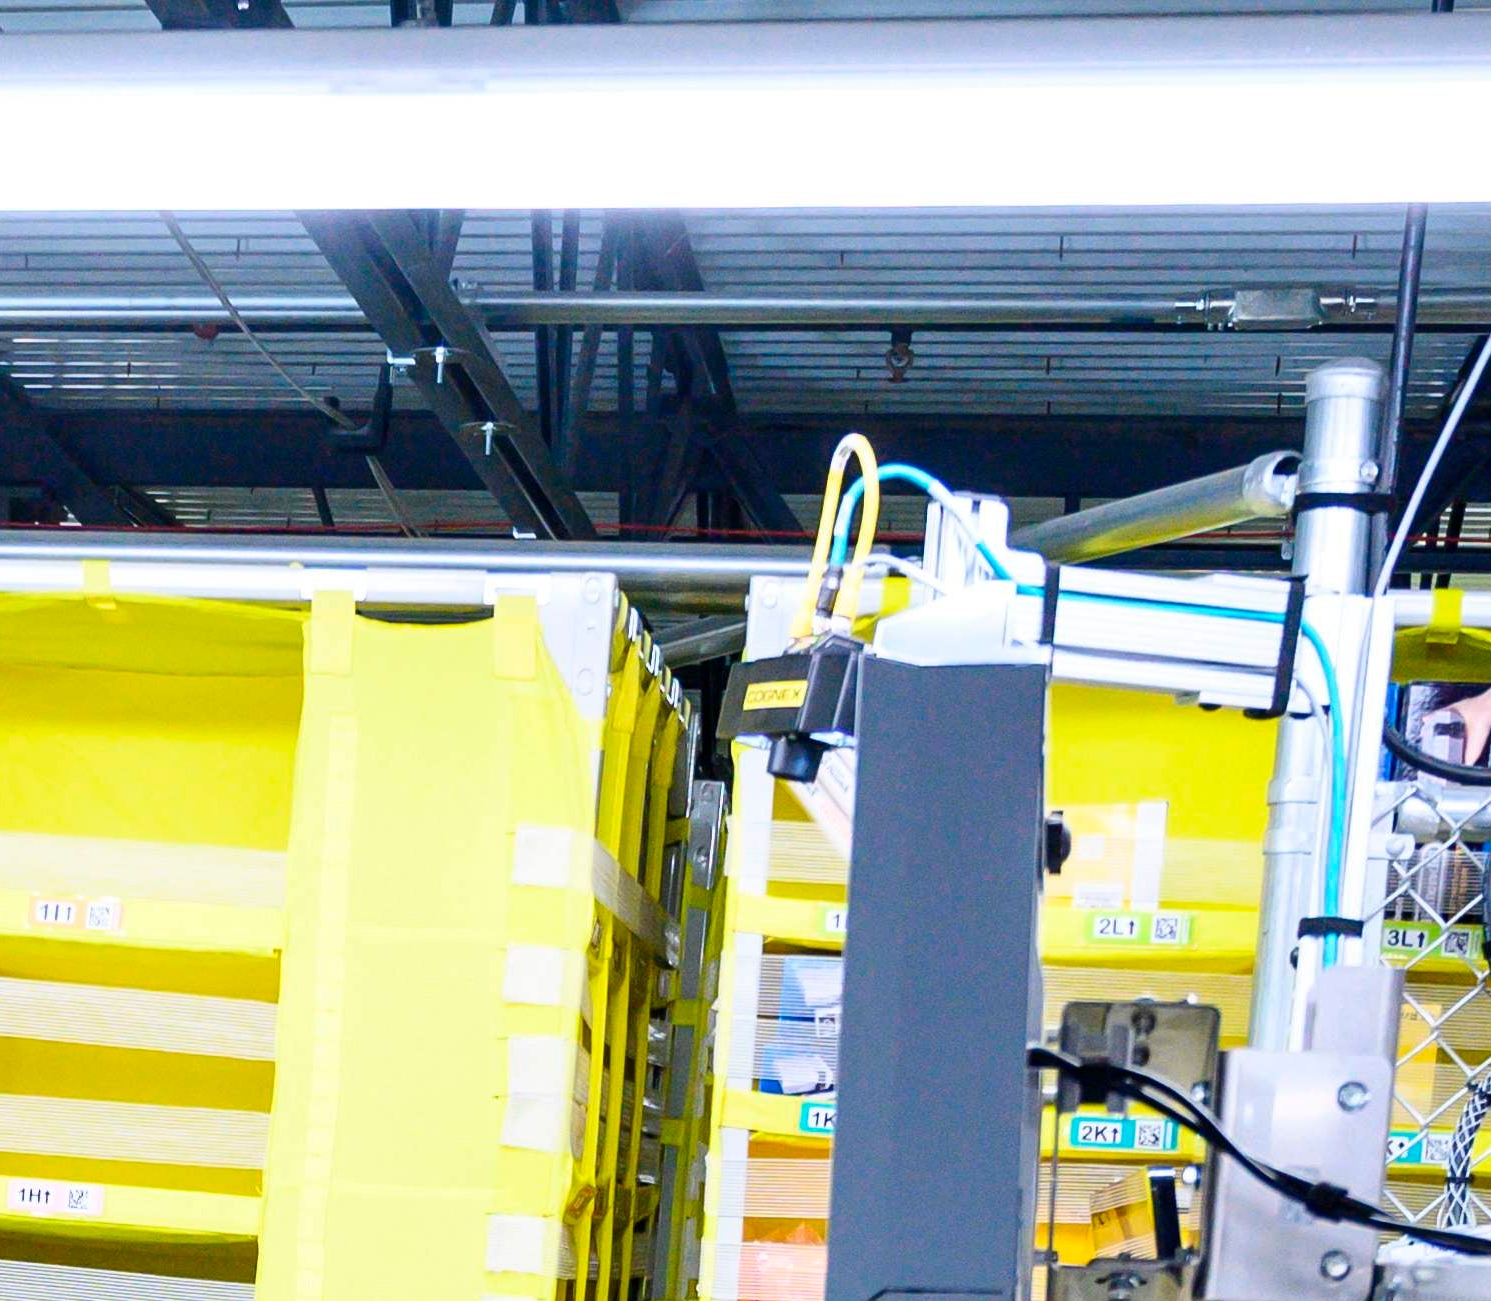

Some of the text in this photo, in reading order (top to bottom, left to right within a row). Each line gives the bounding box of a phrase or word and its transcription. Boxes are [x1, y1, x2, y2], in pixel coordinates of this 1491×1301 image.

[746, 687, 803, 705] COGNEX
[1099, 918, 1125, 936] 2L
[1387, 931, 1415, 948] 3L
[1081, 1125, 1107, 1142] 2K
